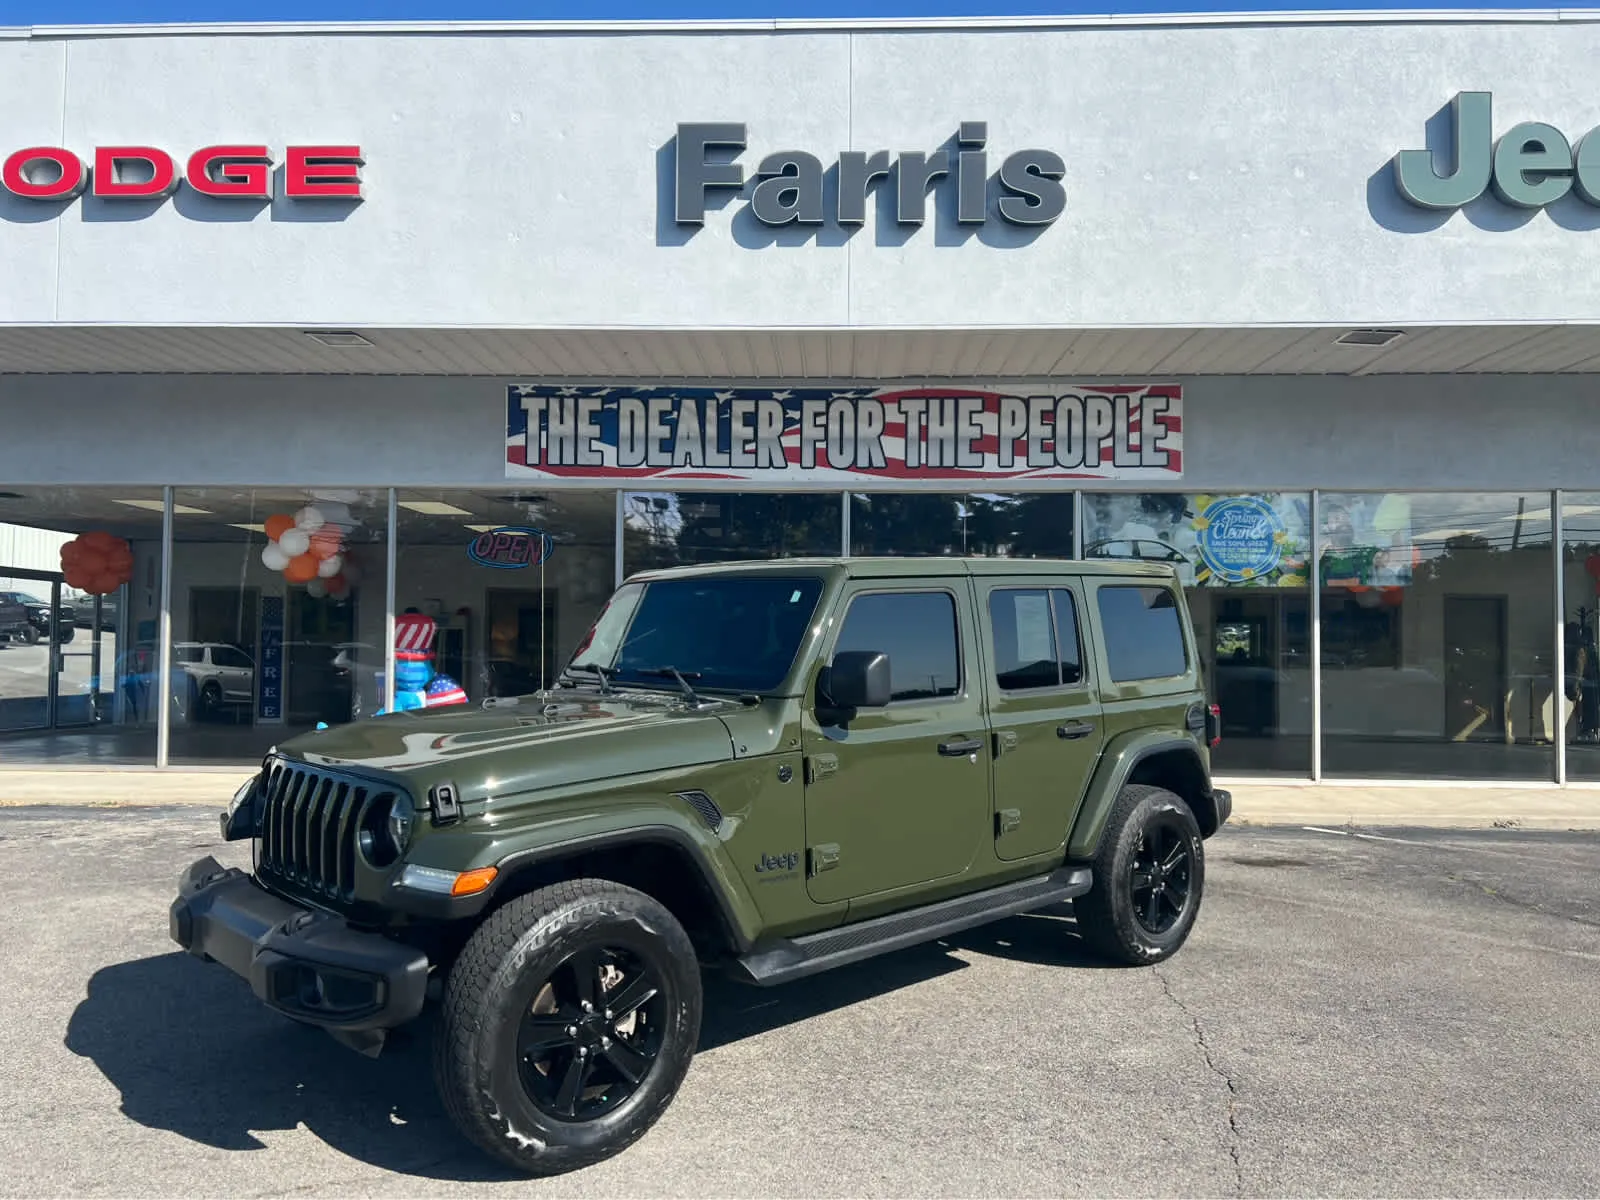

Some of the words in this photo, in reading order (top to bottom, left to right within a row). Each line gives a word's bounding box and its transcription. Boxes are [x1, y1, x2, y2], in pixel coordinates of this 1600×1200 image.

[2, 145, 364, 201] ODGE
[675, 121, 1067, 226] Farris
[1394, 90, 1600, 209] Je
[519, 396, 604, 467] THE
[616, 397, 787, 469] DEALER
[800, 397, 886, 469] FOR
[898, 396, 985, 468] THE
[998, 395, 1169, 468] PEOPLE
[1211, 519, 1249, 539] Clean
[1223, 510, 1257, 529] Spring
[475, 532, 541, 565] OPEN
[263, 648, 277, 717] FREE
[755, 852, 799, 873] Jeep
